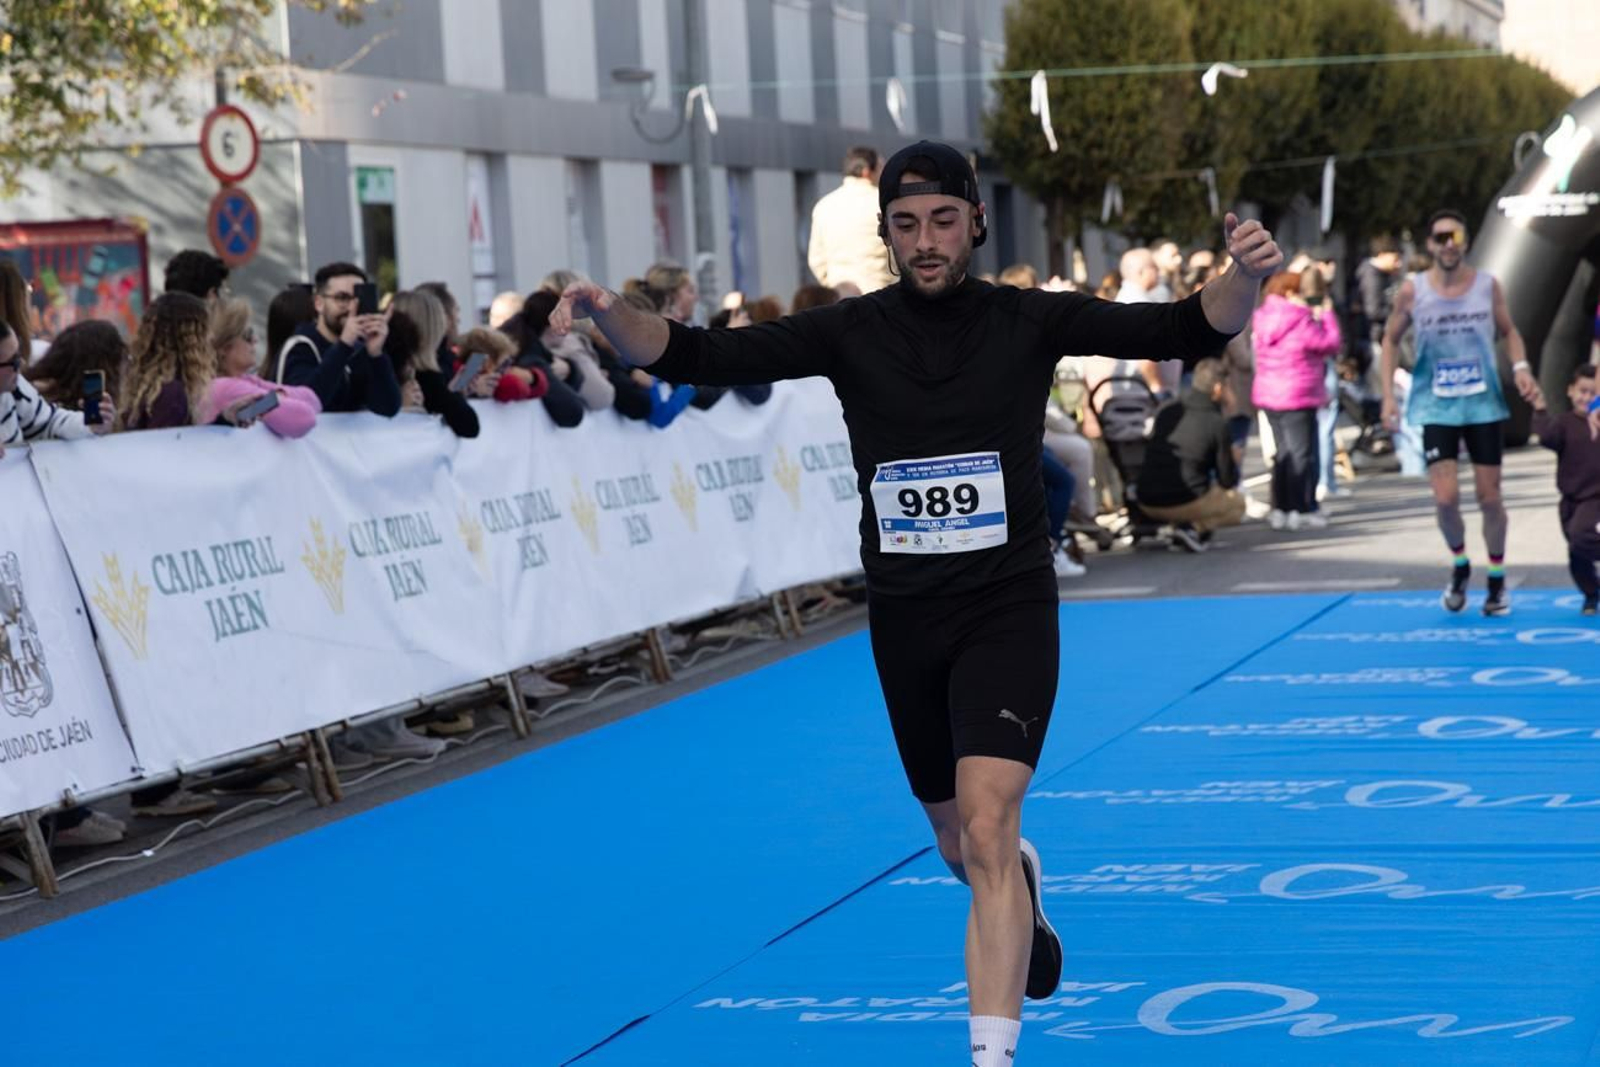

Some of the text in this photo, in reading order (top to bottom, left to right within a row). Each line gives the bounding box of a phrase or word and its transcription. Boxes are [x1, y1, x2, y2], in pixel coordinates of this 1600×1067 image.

[1437, 365, 1480, 384] 2054
[898, 483, 979, 517] 989
[384, 511, 443, 552] RURAL
[914, 520, 942, 528] MIGUEL
[151, 536, 285, 596] CAJA RURAL
[205, 586, 270, 642] JAÉN
[37, 728, 58, 752] DE
[60, 716, 93, 748] JAÉN
[694, 996, 1102, 1011] MRATÓN
